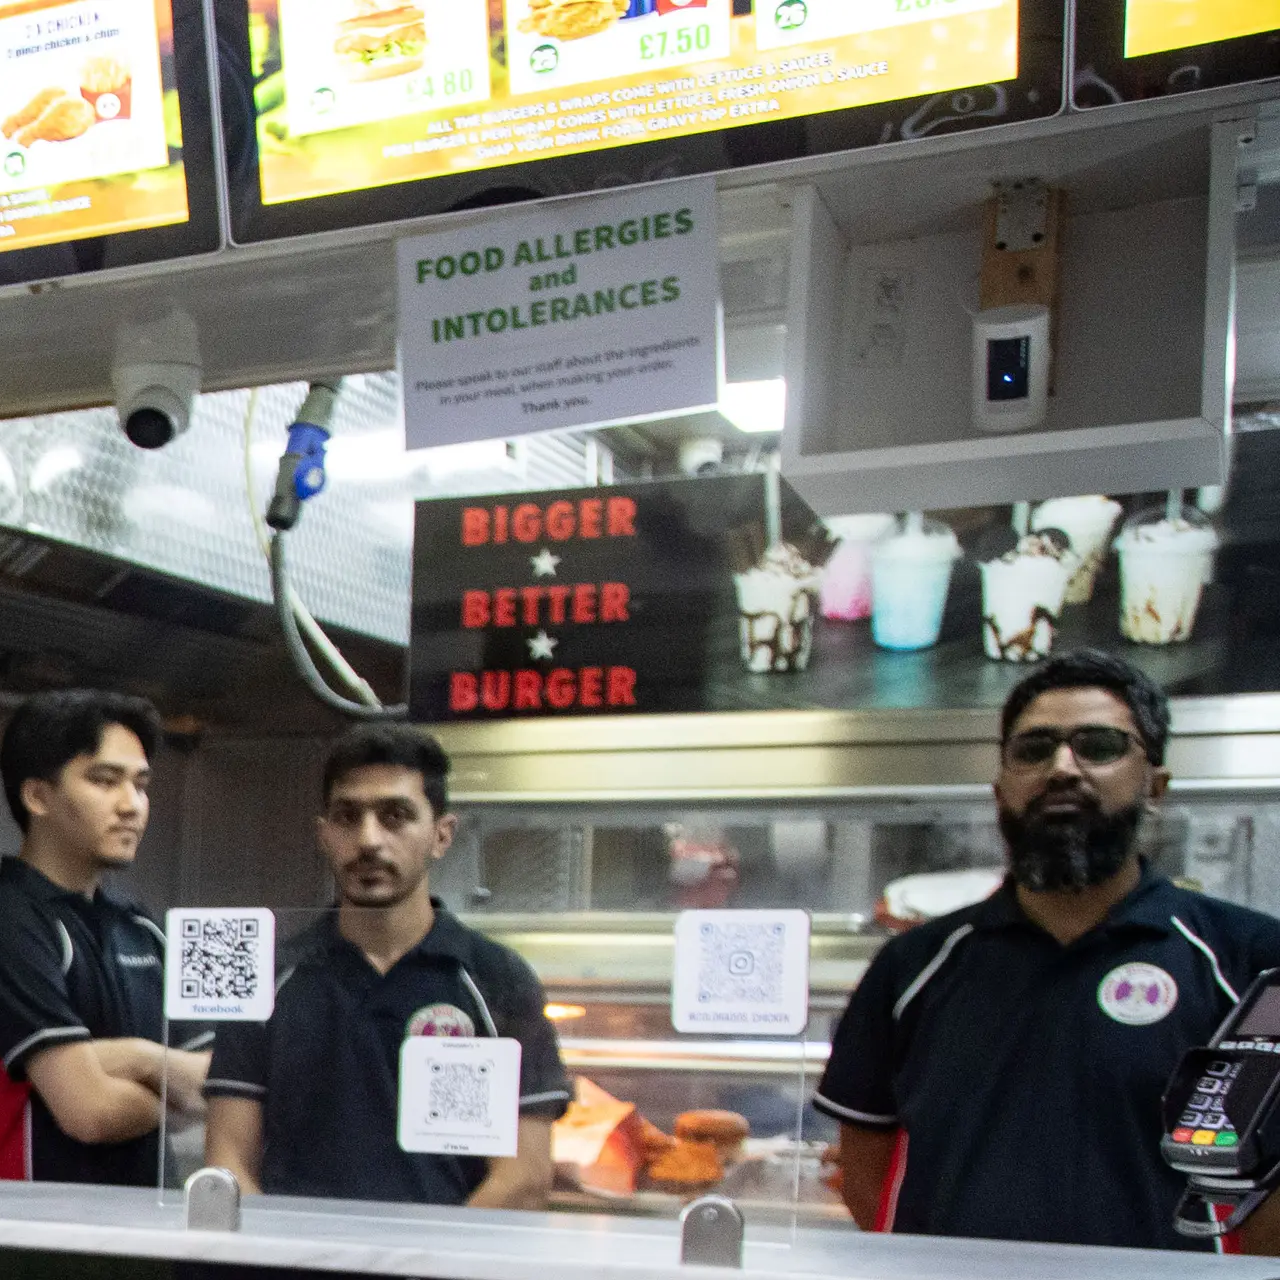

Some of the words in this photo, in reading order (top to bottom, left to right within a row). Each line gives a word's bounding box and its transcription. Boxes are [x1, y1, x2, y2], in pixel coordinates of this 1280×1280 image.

[639, 23, 711, 60] £7.50
[426, 118, 453, 135] ALL
[559, 91, 610, 112] WRAPS
[611, 84, 655, 106] COME
[657, 77, 696, 96] WITH
[697, 65, 764, 89] LETTUCE
[513, 117, 556, 139] WRAP
[557, 108, 608, 130] COMES
[610, 103, 646, 121] WITH
[717, 82, 767, 105] FRESH
[768, 73, 820, 95] ONION
[836, 60, 889, 82] SAUCE
[648, 109, 700, 133] GRAVY
[728, 97, 781, 119] EXTRA
[416, 246, 506, 284] FOOD
[512, 207, 696, 267] ALLERGIES
[528, 262, 578, 293] and
[431, 275, 682, 344] INTOLERANCES
[564, 352, 602, 371] about
[602, 349, 624, 364] the
[521, 398, 562, 415] Thank
[461, 496, 638, 547] BIGGER
[461, 582, 631, 628] BETTER
[448, 666, 638, 713] BURGER
[192, 1003, 244, 1015] facebook
